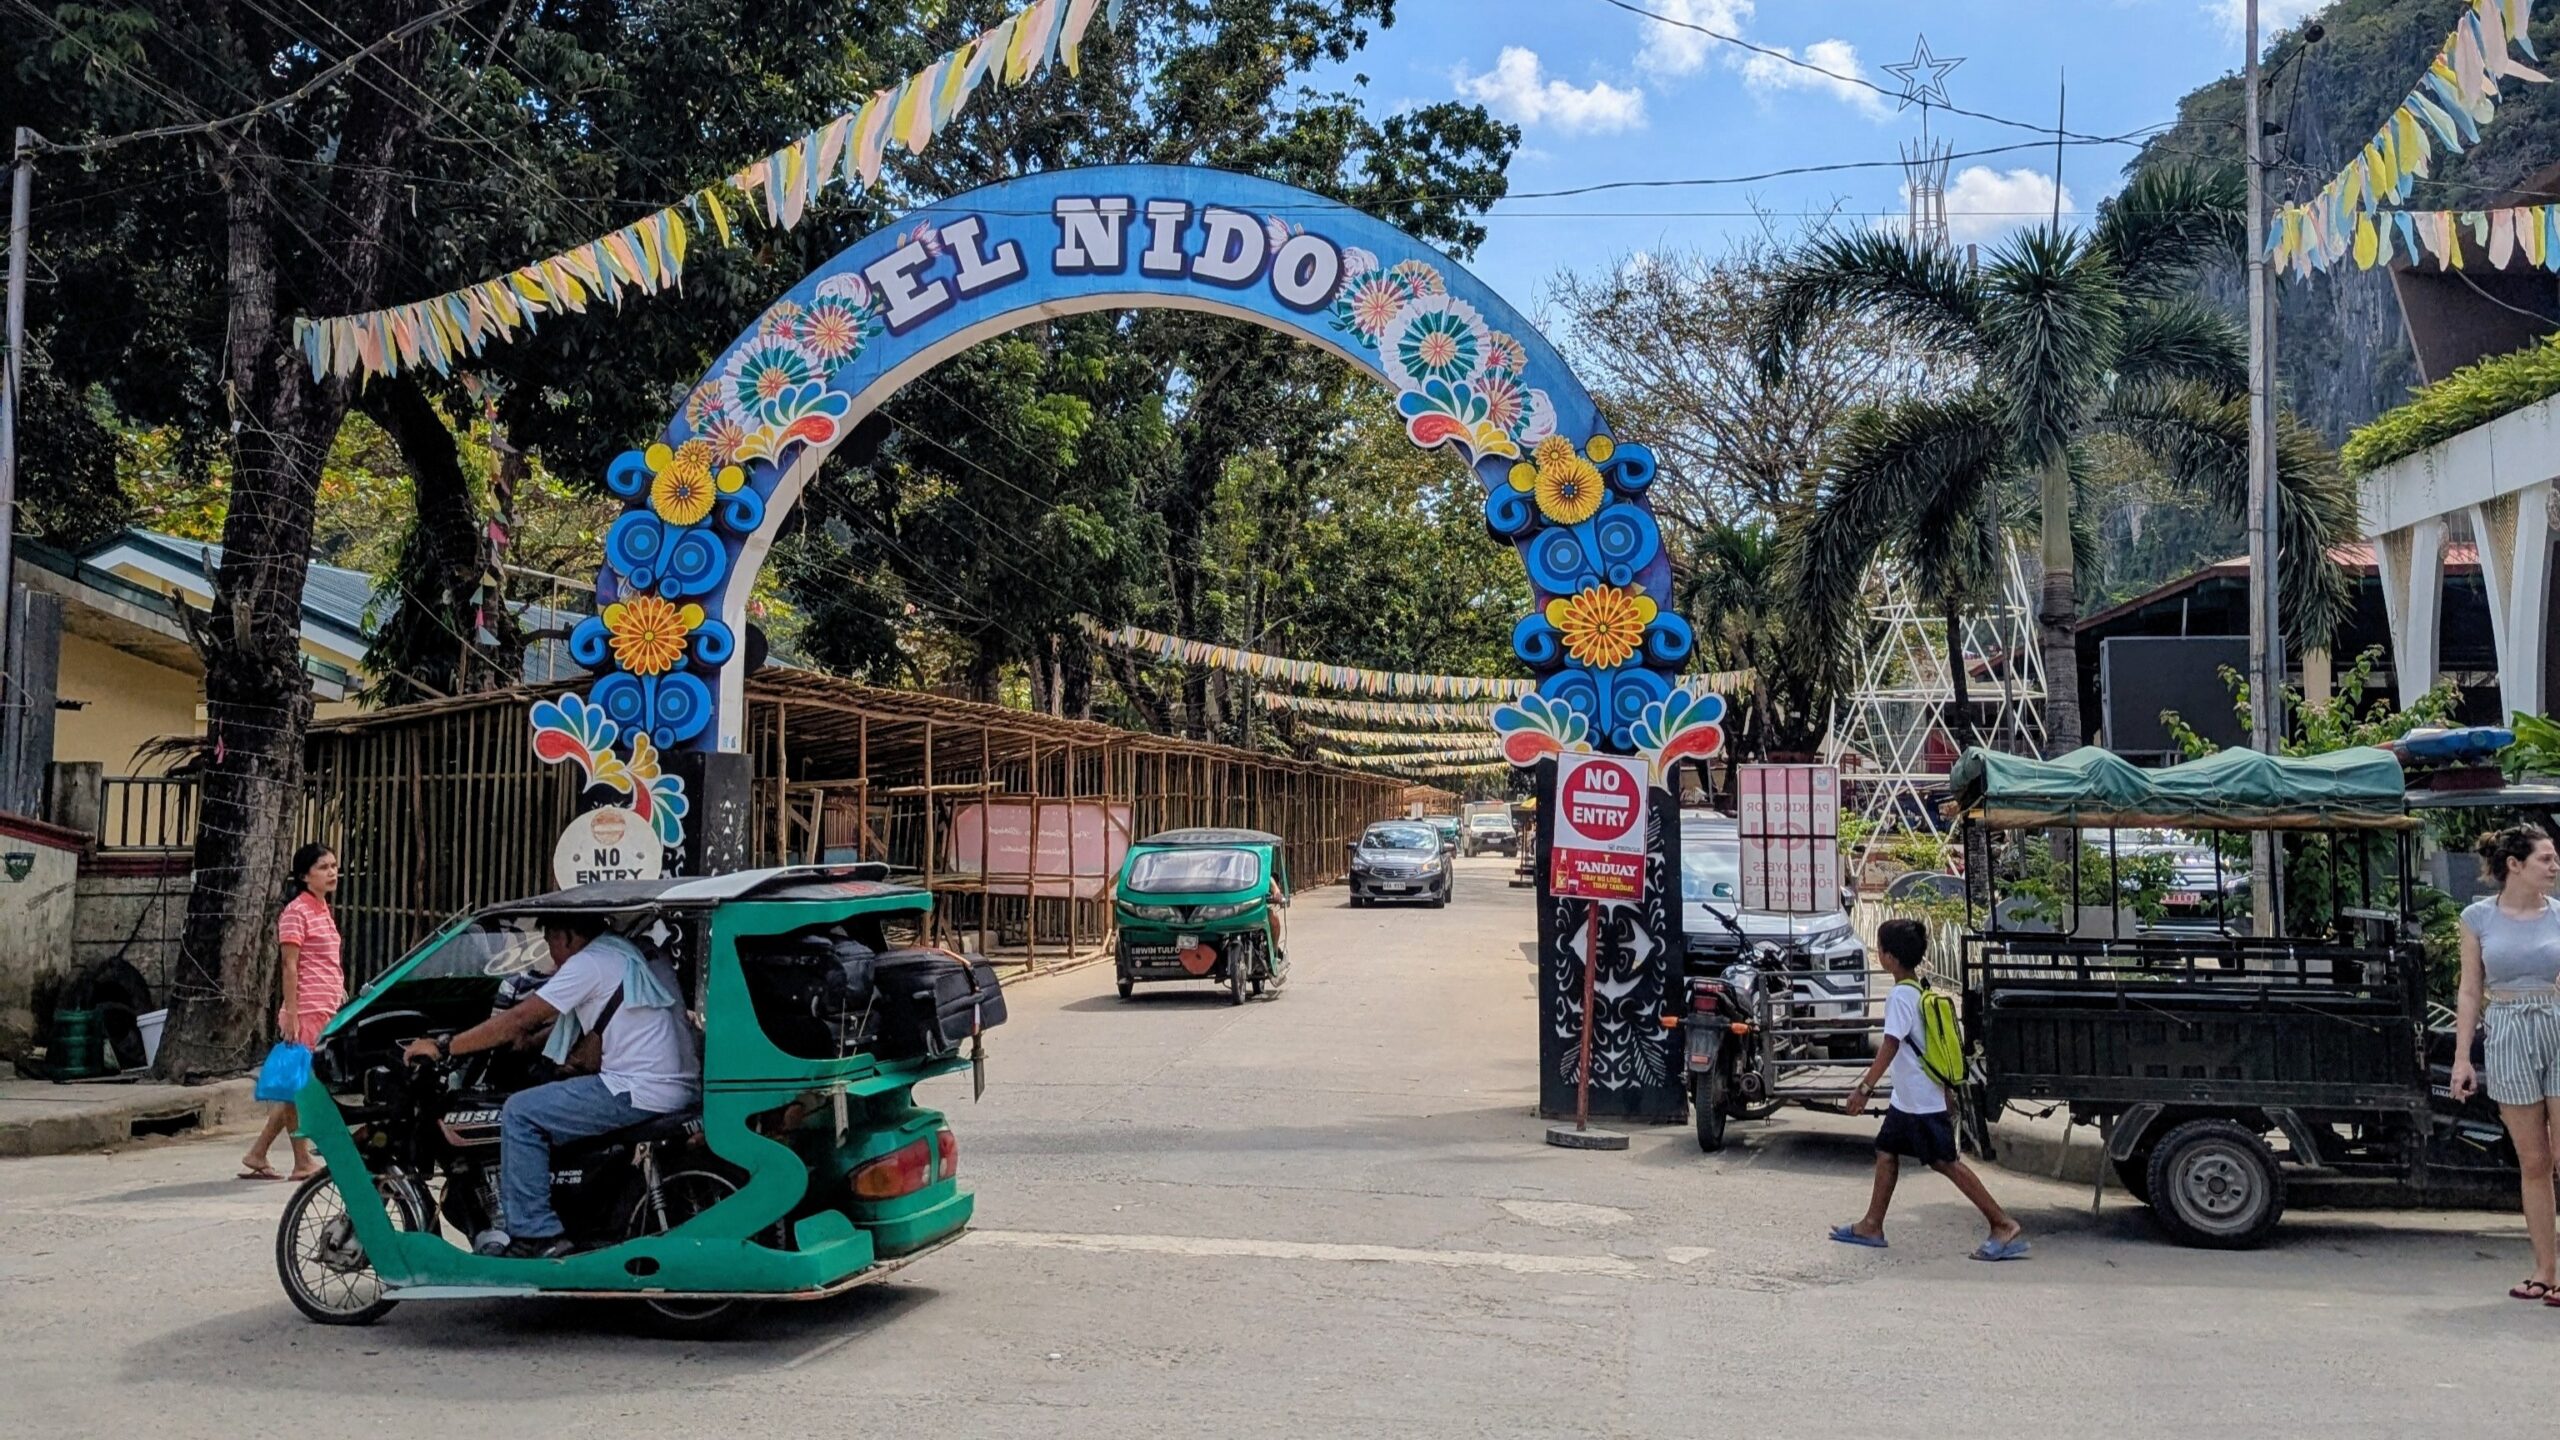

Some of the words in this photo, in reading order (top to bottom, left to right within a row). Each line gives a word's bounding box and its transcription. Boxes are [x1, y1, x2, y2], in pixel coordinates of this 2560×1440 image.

[863, 214, 1022, 329] EL
[1054, 197, 1340, 306] NIDO
[1584, 767, 1620, 791] NO
[1572, 806, 1629, 828] ENTRY
[594, 848, 620, 867] NO
[576, 868, 644, 884] ENTRY
[1574, 860, 1638, 877] TANDUAY
